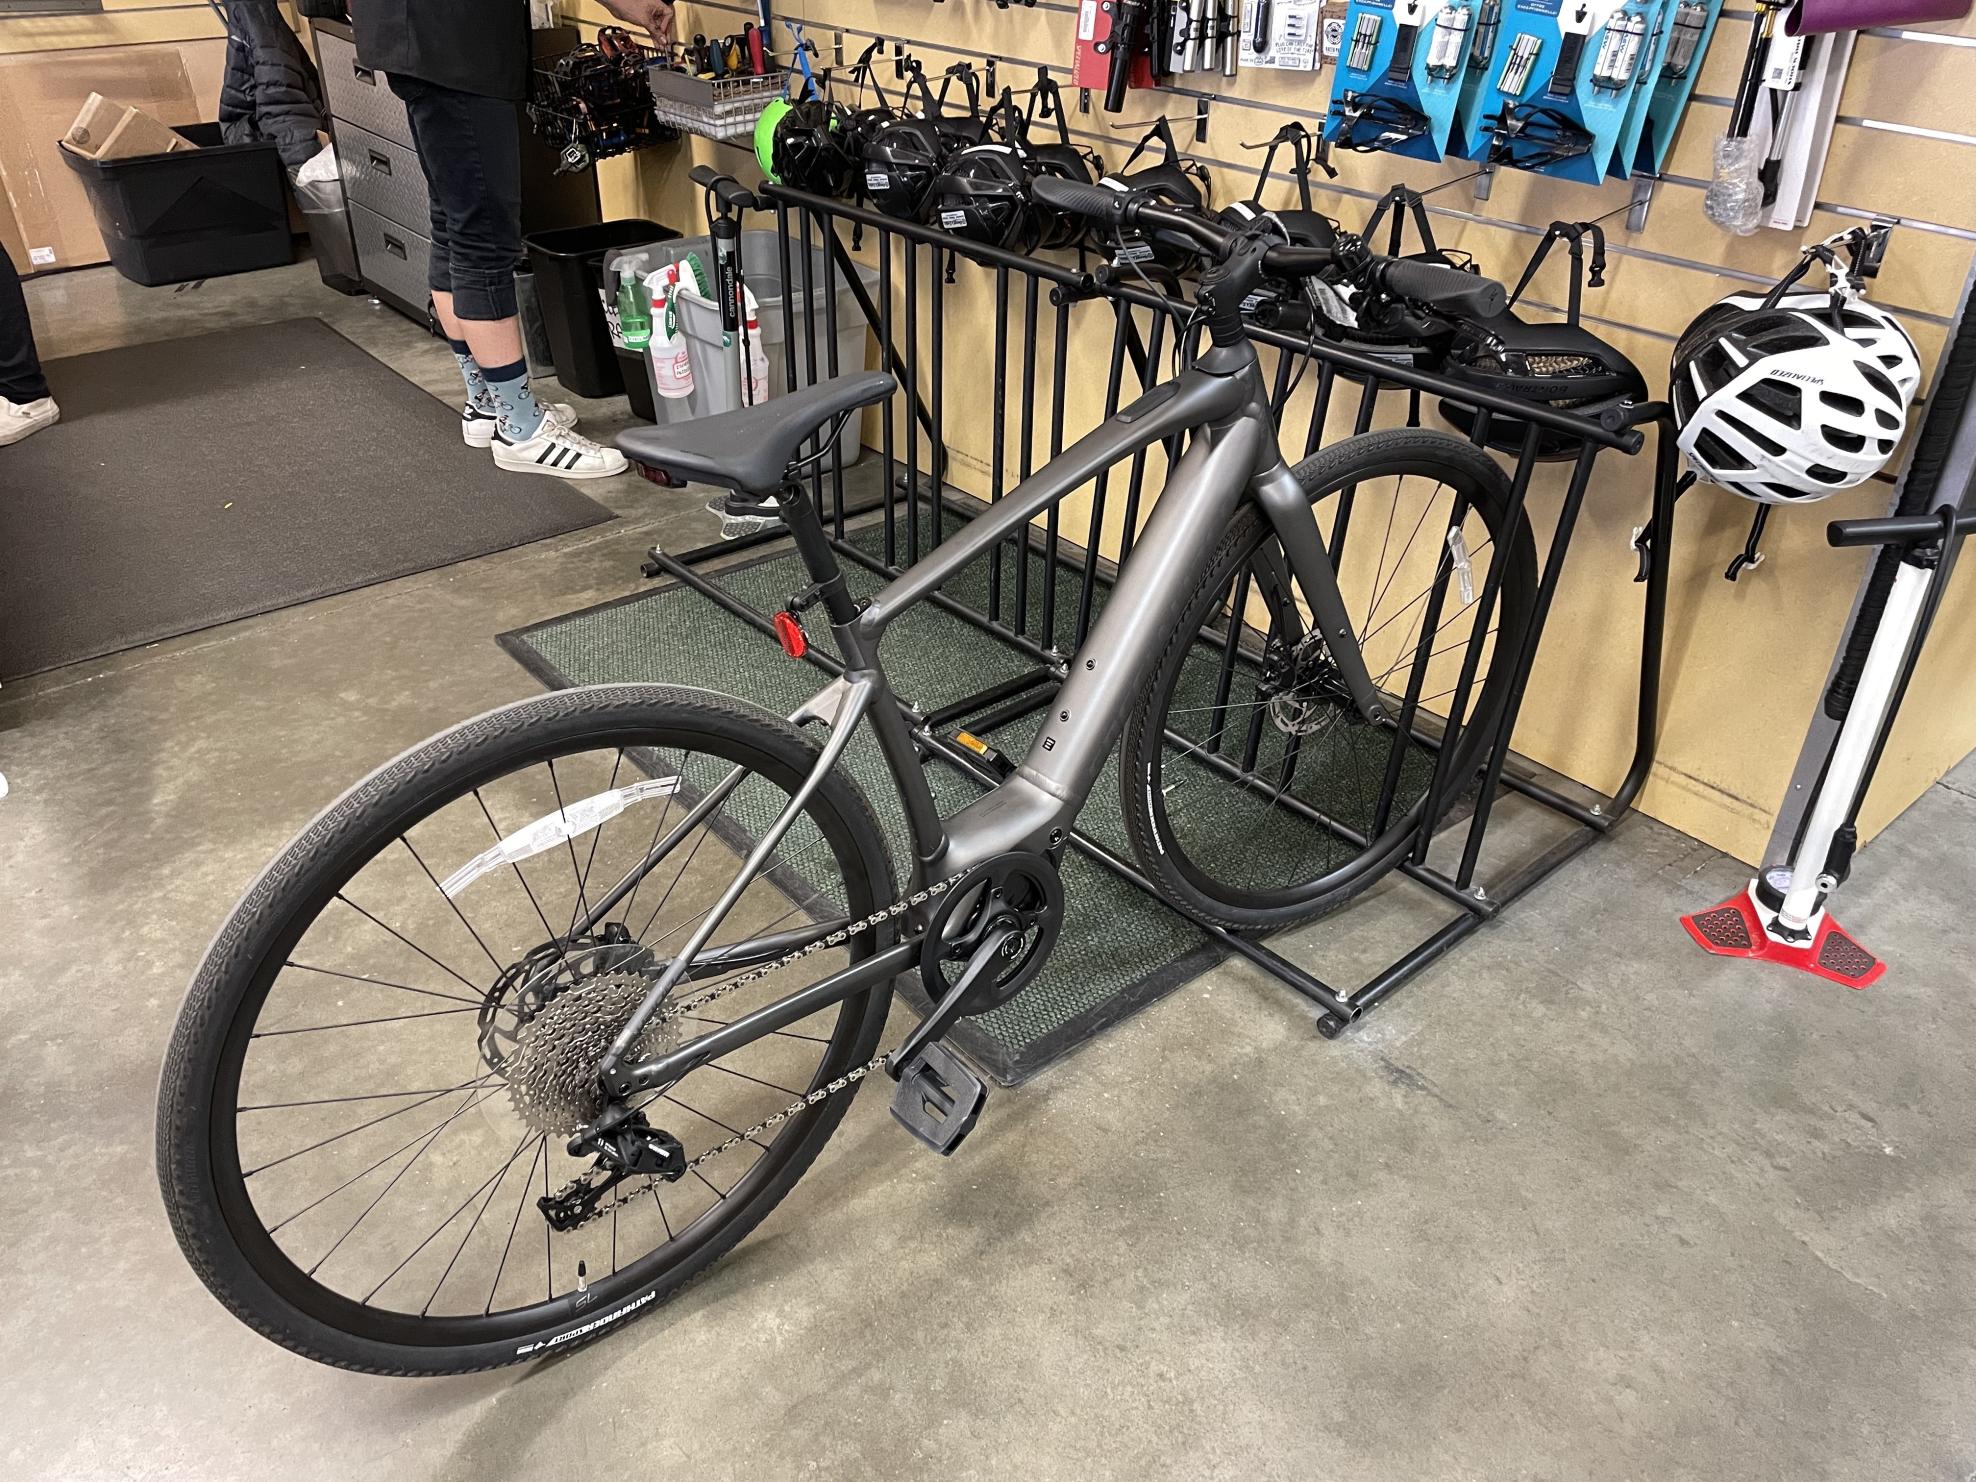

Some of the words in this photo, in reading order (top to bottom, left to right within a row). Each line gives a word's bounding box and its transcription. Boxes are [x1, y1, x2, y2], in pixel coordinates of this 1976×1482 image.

[1770, 369, 1824, 385] SPECIALIZED
[575, 1292, 598, 1312] SL
[588, 1290, 656, 1331] PATHFINDER
